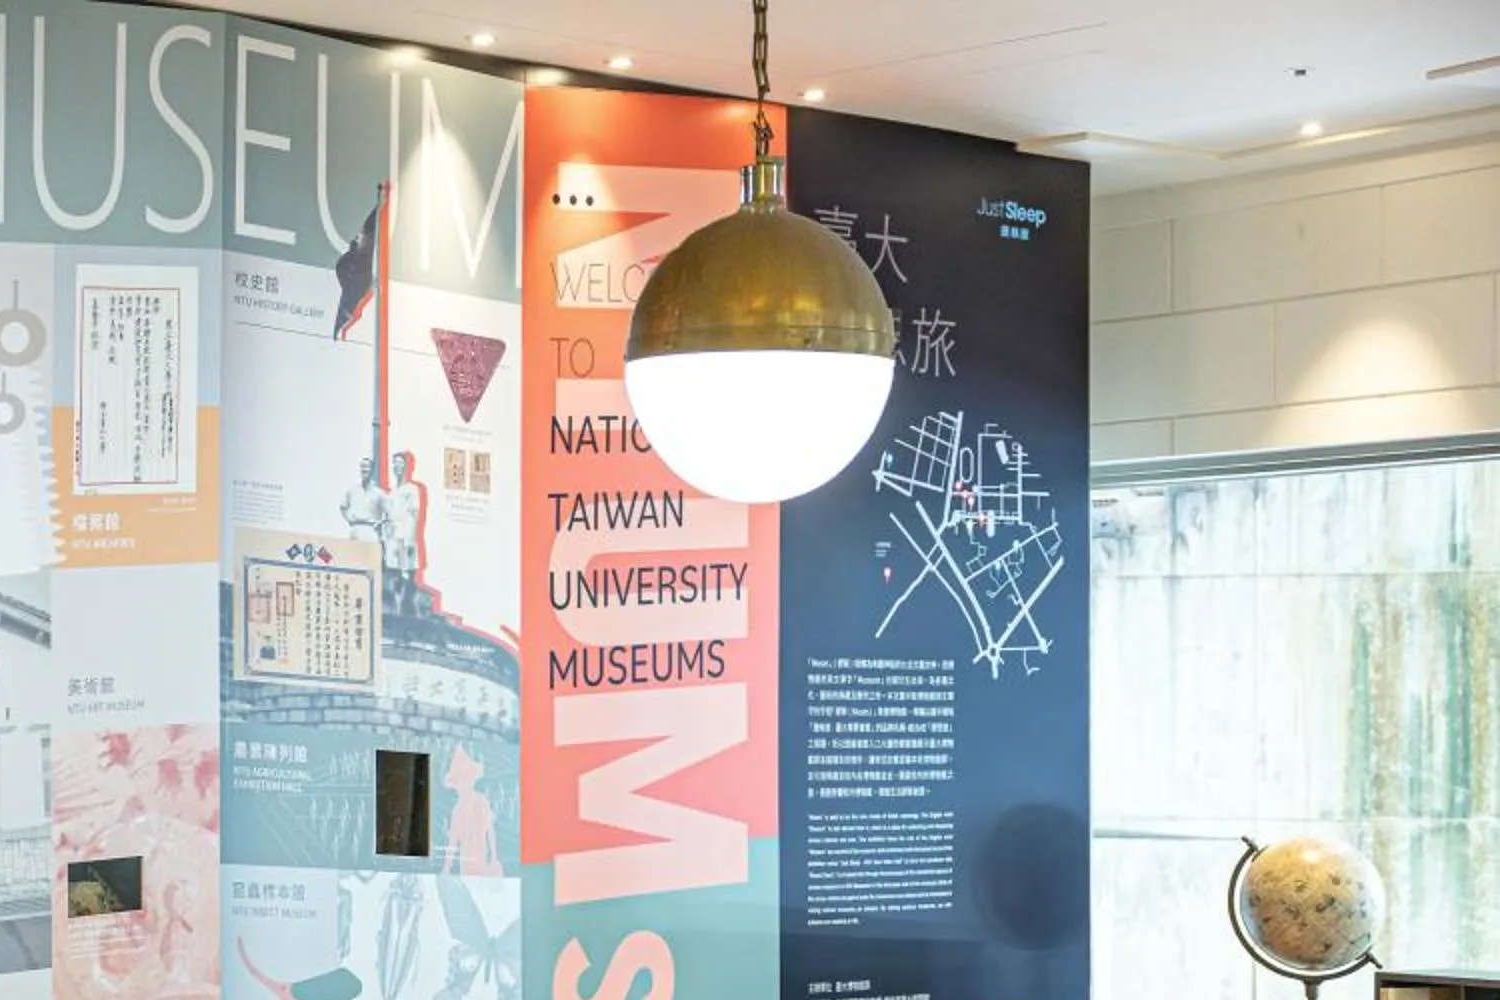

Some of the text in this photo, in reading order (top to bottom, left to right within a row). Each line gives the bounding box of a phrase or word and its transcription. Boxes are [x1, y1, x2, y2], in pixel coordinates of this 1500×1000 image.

[550, 262, 645, 304] WELC
[550, 337, 595, 379] TO
[892, 307, 956, 377] 旅
[550, 415, 652, 455] NATIO
[549, 490, 683, 532] TAIWAN
[549, 563, 748, 610] UNIVERSITY
[549, 639, 726, 690] MUSEUMS
